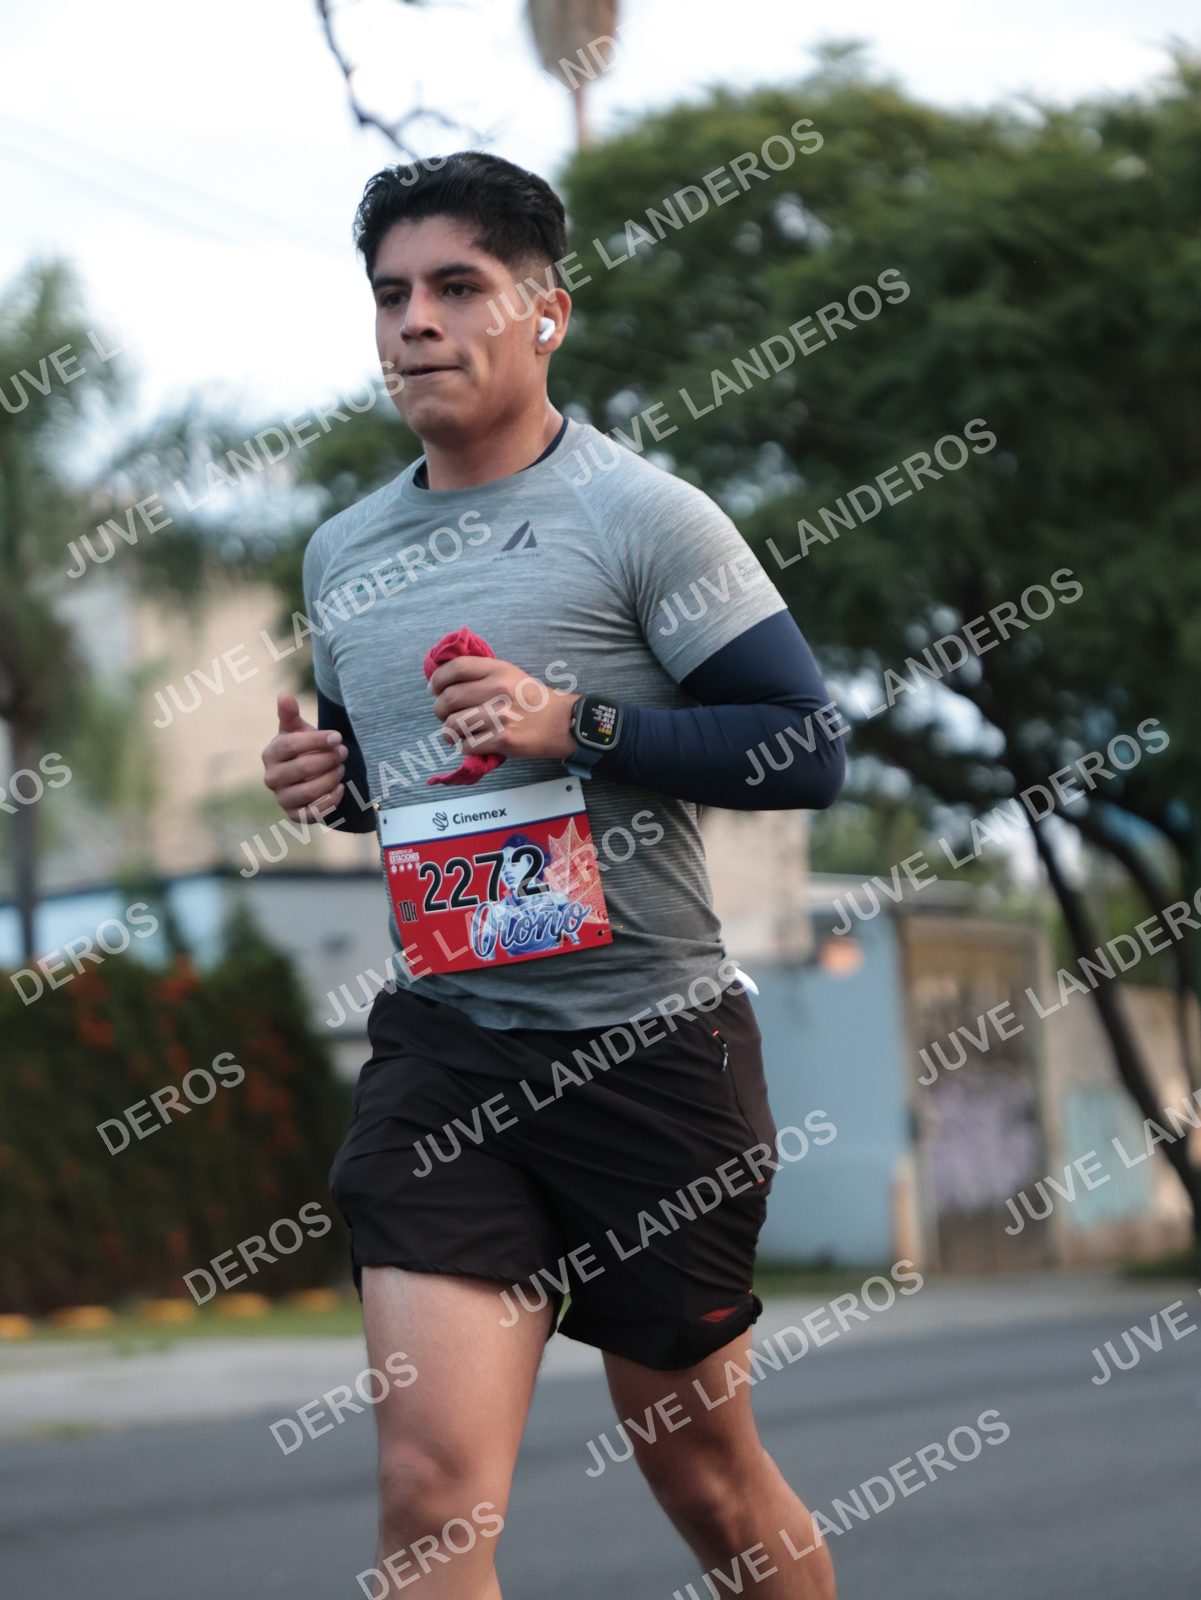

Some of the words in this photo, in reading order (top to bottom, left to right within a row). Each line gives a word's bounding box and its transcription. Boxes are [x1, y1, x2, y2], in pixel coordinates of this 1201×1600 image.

[453, 808, 507, 825] Cinemex
[418, 845, 549, 914] 2272
[398, 900, 418, 922] 10k
